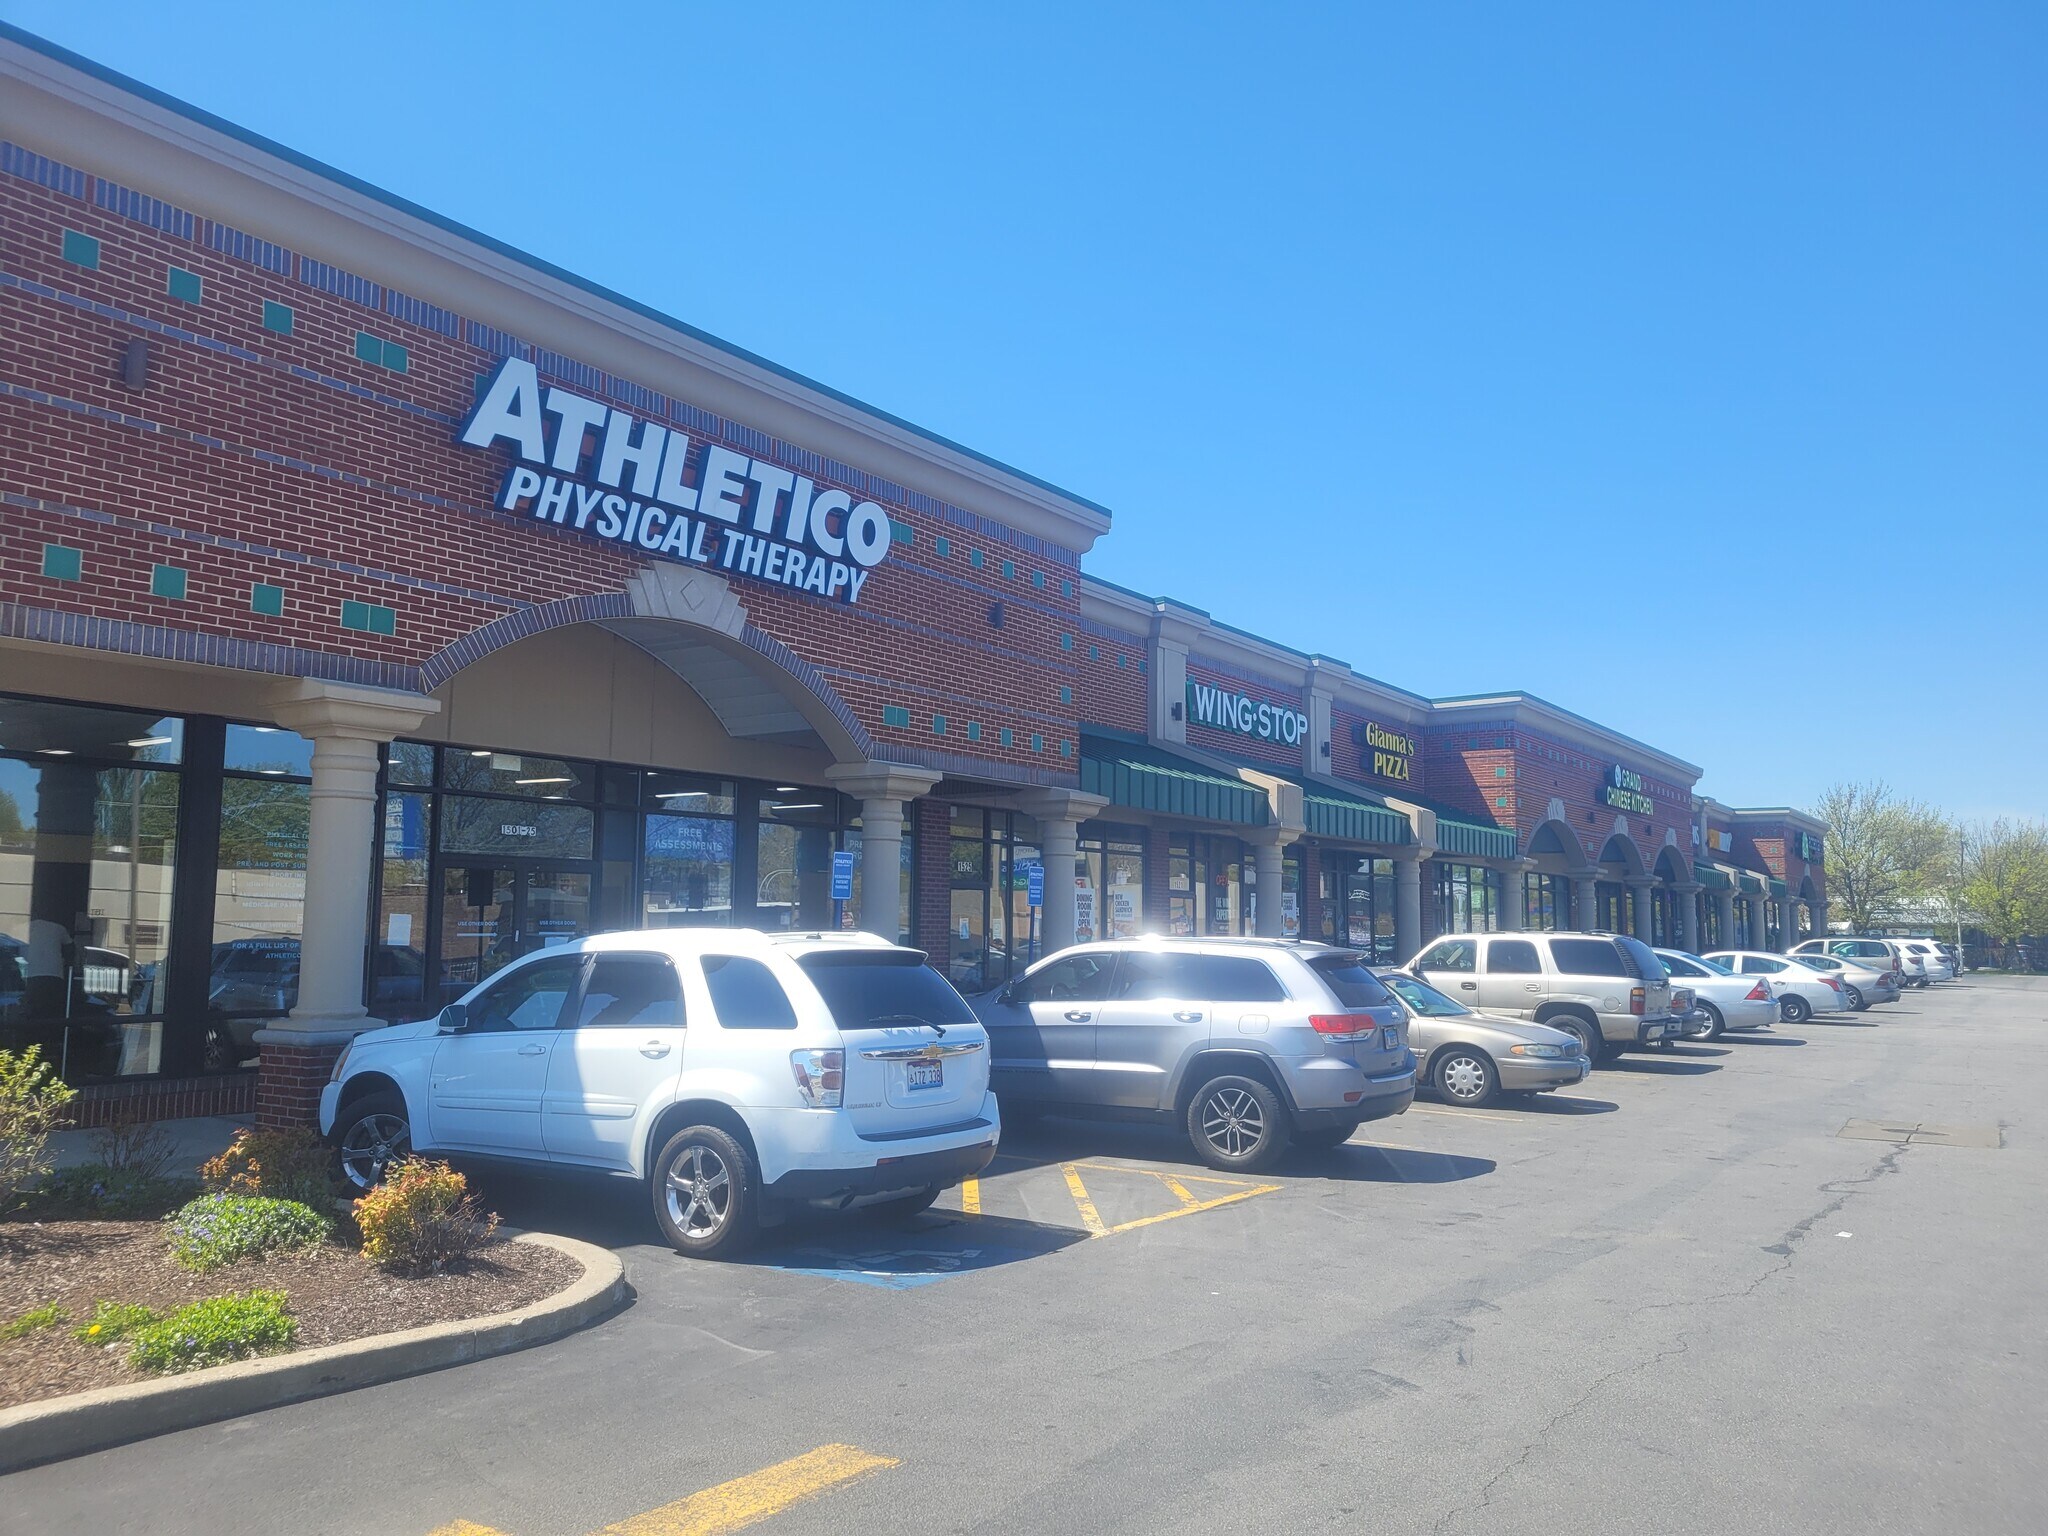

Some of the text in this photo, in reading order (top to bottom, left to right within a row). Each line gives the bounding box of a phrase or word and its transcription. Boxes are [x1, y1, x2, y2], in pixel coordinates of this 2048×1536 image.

[461, 356, 890, 567] ATHLETICO
[503, 466, 869, 604] PHYSICAL THERAPY
[1366, 721, 1414, 757] Gianna's
[1374, 751, 1410, 782] PIZZA
[1622, 768, 1642, 792] GRAND
[1606, 785, 1654, 816] CHINESE KITCHEN
[502, 825, 537, 836] 1501-25
[677, 827, 703, 837] FREE
[654, 838, 724, 851] ASSESSMENTS
[1076, 893, 1093, 903] DINING
[1077, 902, 1092, 911] ROOM
[1078, 910, 1091, 919] NOW
[1077, 918, 1091, 927] OPEN
[914, 1069, 941, 1085] 172 338
